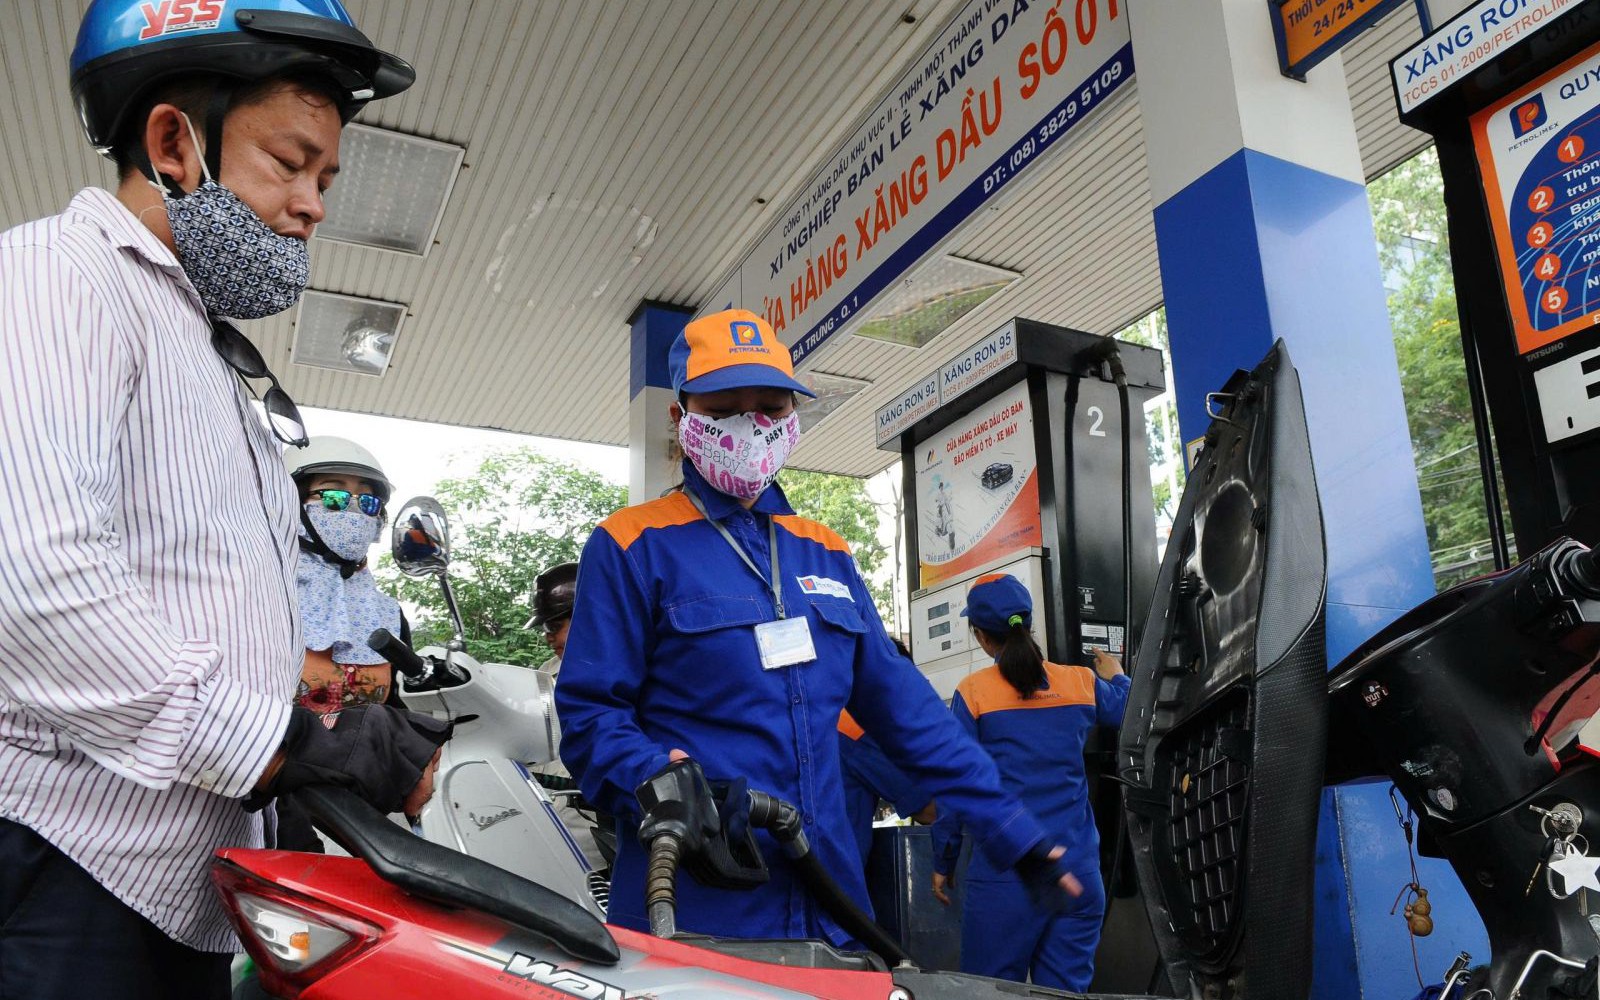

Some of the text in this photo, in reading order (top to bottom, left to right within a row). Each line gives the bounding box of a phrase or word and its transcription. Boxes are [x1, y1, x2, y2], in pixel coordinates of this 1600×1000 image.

[1404, 24, 1474, 84] XĂNG
[1403, 75, 1438, 106] TCCS
[783, 210, 801, 238] CÔNG
[801, 199, 811, 217] TY
[850, 140, 866, 164] KHU
[868, 118, 886, 143] VỰC
[899, 74, 923, 109] TNHH
[925, 48, 945, 81] MỘT
[948, 7, 982, 55] THÀNH
[983, 61, 1122, 194] ĐT: (08) 3829 5109
[1508, 121, 1559, 153] PETROLIMEX
[770, 245, 783, 281] XÍ
[787, 190, 842, 261] NGHIỆP
[847, 143, 884, 197] BÁN
[889, 109, 912, 152] LẺ
[918, 38, 984, 122] XĂNG
[790, 233, 848, 321] HÀNG
[855, 154, 929, 261] XĂNG
[935, 75, 1003, 183] DẦU
[1018, 0, 1068, 100] SỐ
[1564, 140, 1576, 158] 1
[1562, 159, 1600, 182] Thôn
[1533, 190, 1549, 211] 2
[1566, 182, 1588, 197] trụ
[1533, 226, 1547, 245] 3
[1540, 257, 1555, 276] 4
[853, 295, 858, 308] 1
[1547, 290, 1562, 310] 5
[944, 330, 1012, 386] XĂNG RON 95
[1525, 341, 1565, 362] TATSUNO
[880, 380, 936, 428] XĂNG RON 92
[704, 423, 723, 438] BOY
[1087, 405, 1106, 437] 2
[765, 426, 783, 446] BABY
[996, 428, 1005, 442] XE
[702, 440, 740, 475] Baby
[469, 808, 522, 832] Vespa
